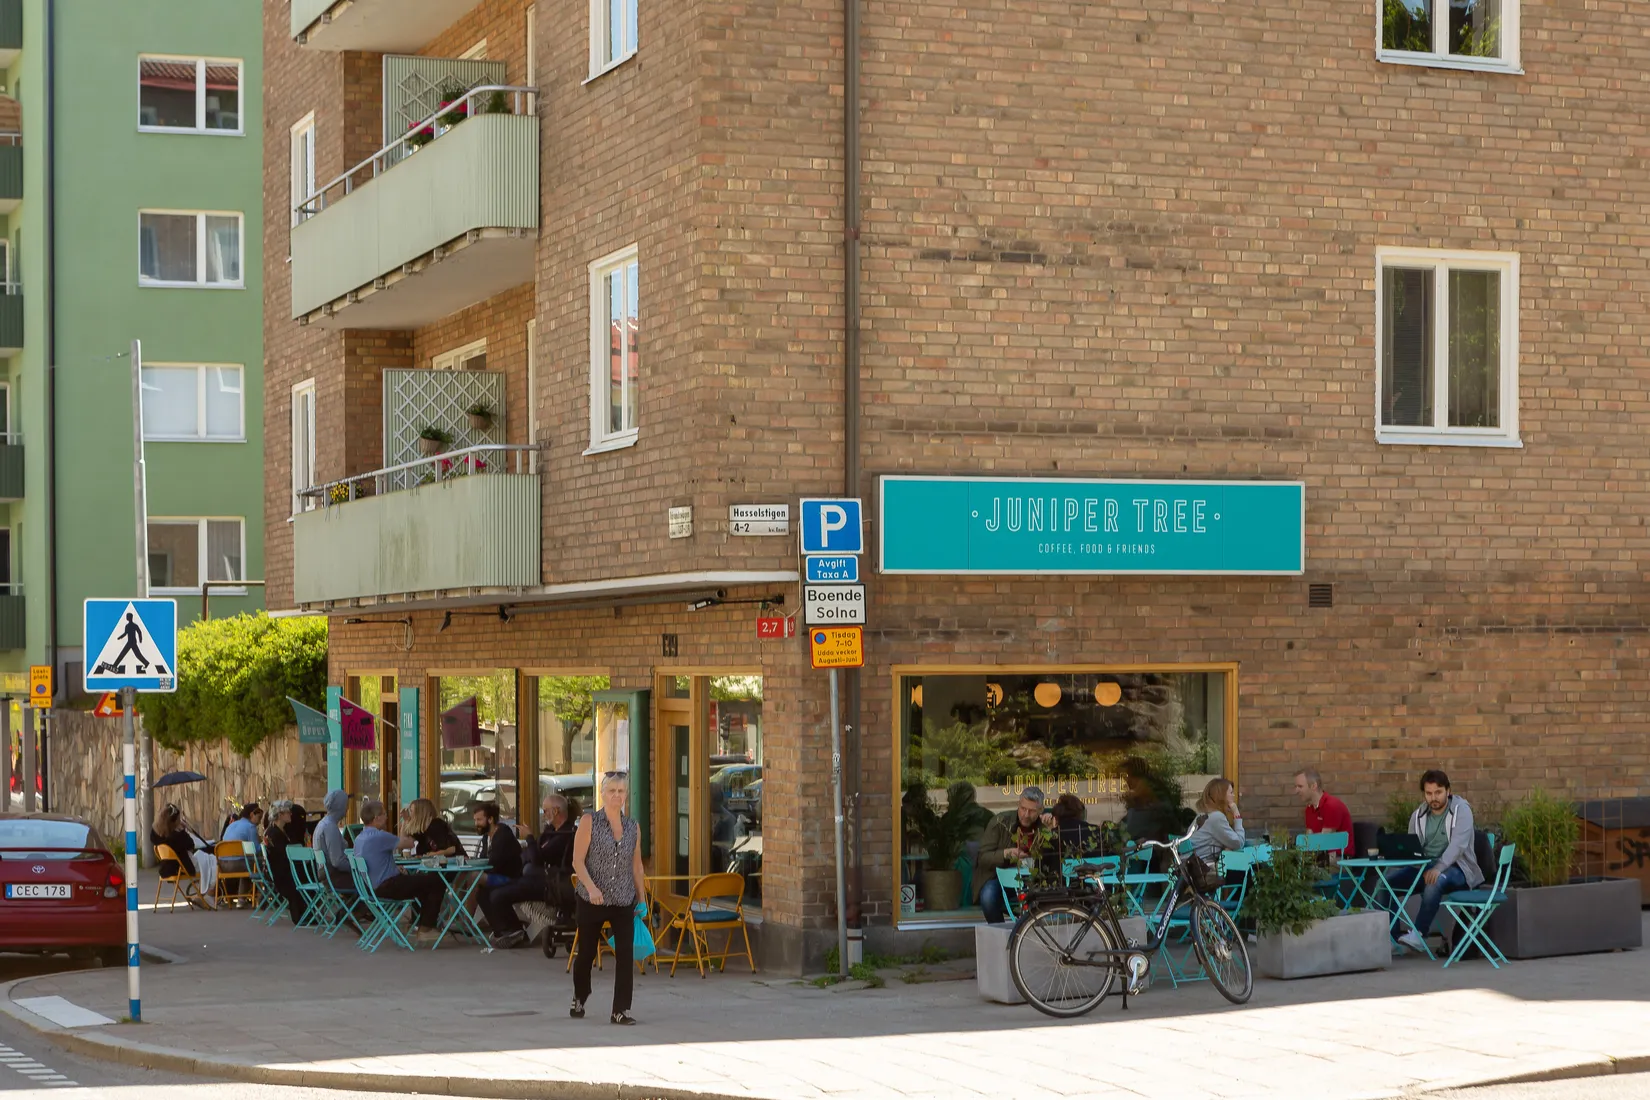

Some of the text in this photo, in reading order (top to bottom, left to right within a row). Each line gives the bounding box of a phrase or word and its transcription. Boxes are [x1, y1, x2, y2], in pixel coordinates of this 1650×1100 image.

[733, 508, 786, 520] Hasselstigen
[986, 497, 1207, 533] JUNIPER TREE
[820, 504, 848, 548] P
[1038, 543, 1155, 555] COFFEE, FOOD & FRIENDS
[818, 559, 847, 570] Avgift
[817, 570, 849, 579] Taxa A
[807, 589, 862, 602] Boende
[816, 606, 857, 619] Solna
[762, 622, 778, 633] 2,7
[831, 632, 856, 640] Tisdag
[16, 885, 66, 896] CEC 178
